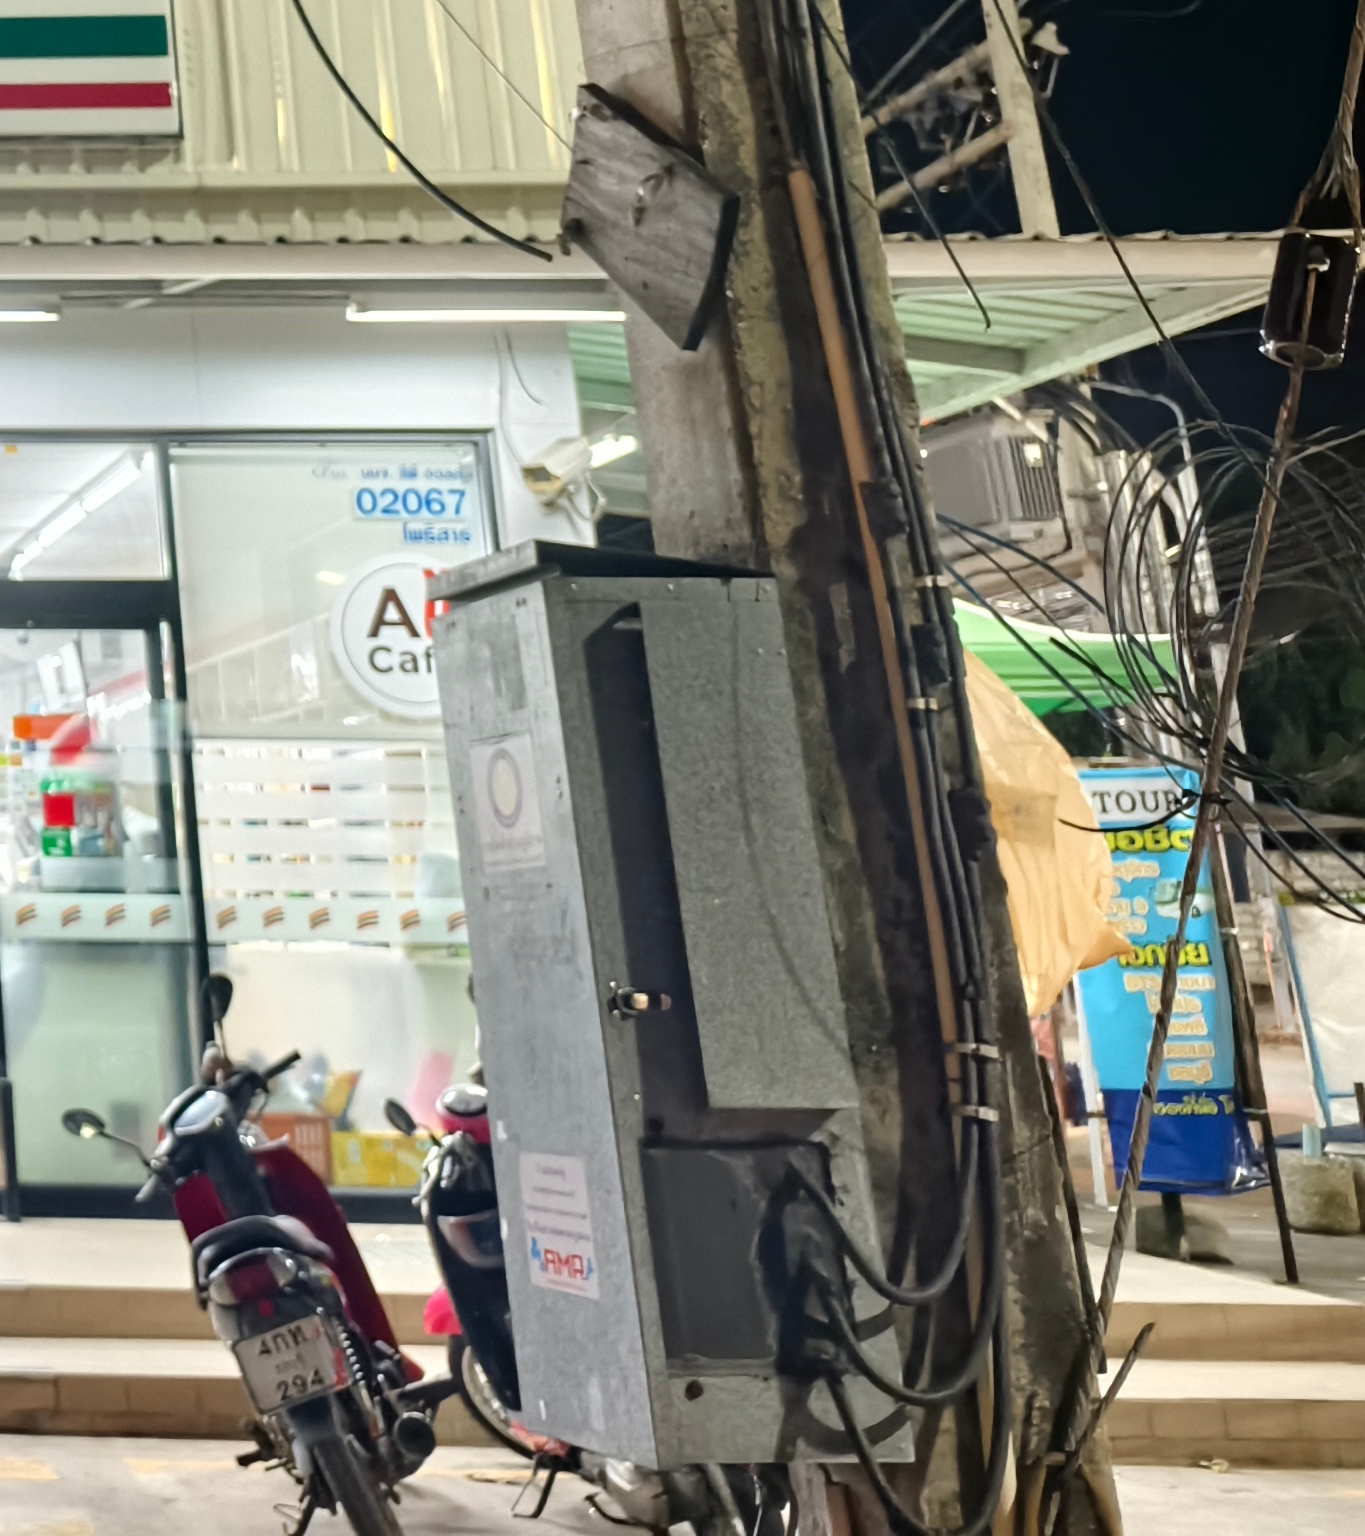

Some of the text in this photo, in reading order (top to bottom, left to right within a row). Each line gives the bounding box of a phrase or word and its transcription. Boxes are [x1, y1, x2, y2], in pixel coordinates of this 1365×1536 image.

[355, 487, 466, 516] 02067
[368, 646, 434, 674] Caf
[276, 1368, 325, 1401] 294
